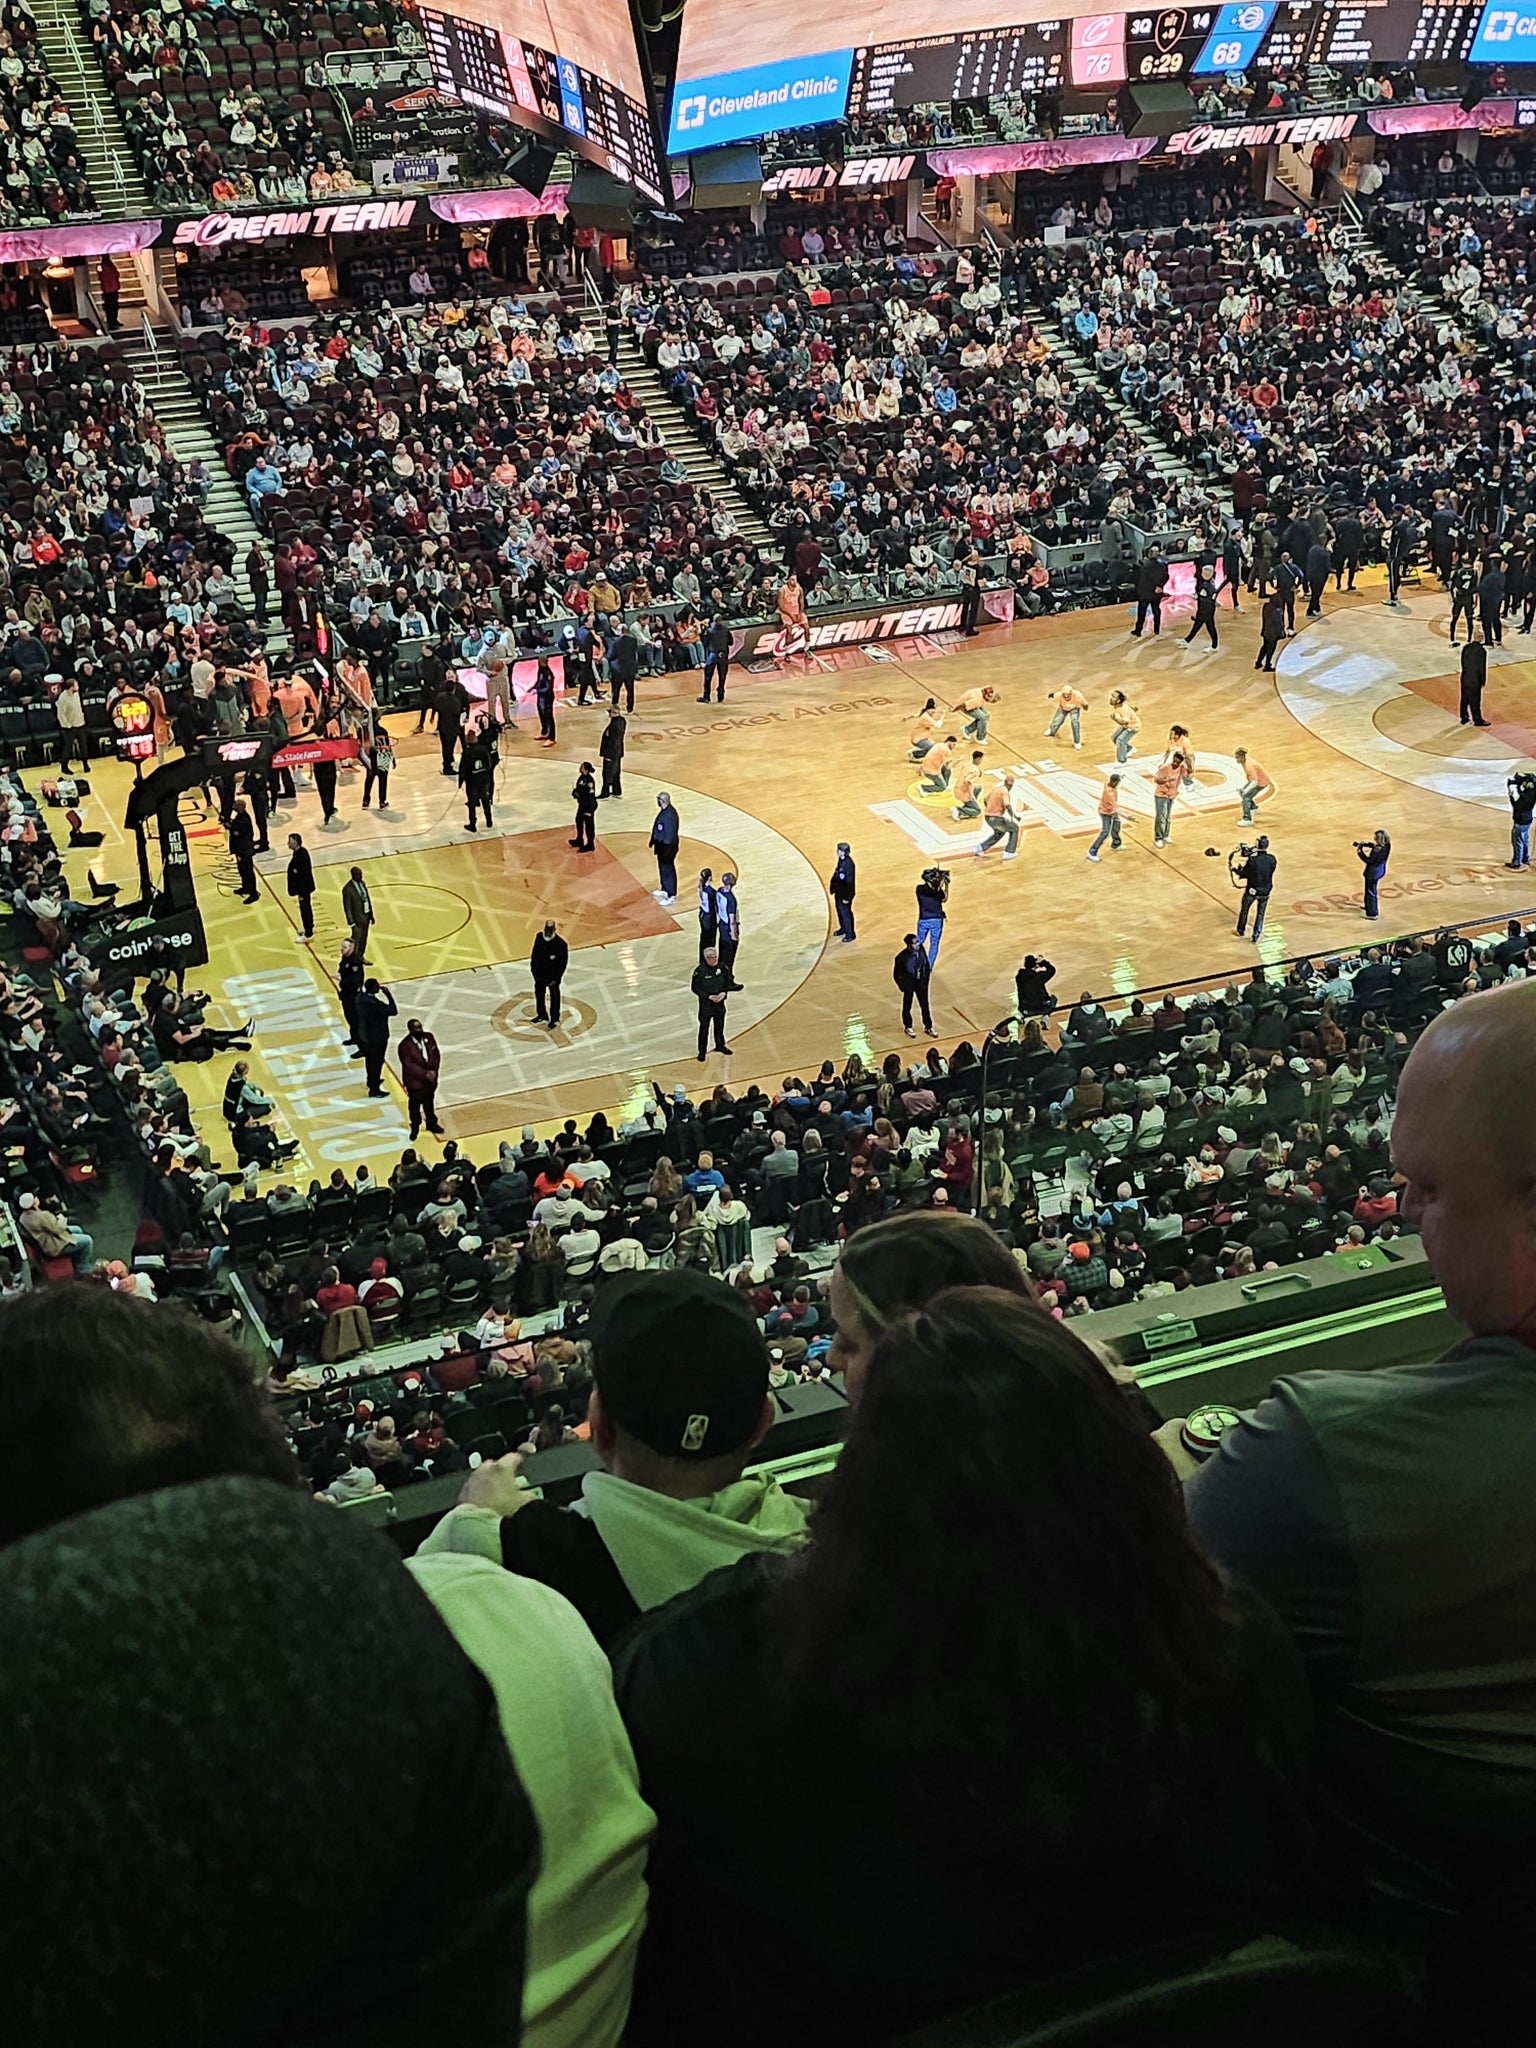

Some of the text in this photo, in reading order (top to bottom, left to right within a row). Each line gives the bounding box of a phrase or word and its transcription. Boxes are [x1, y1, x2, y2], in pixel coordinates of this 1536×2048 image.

[1131, 18, 1152, 35] 3Q
[1192, 13, 1210, 29] 14
[995, 28, 1010, 38] AST
[874, 35, 955, 55] CLEVELAND CAVALIERS
[1212, 42, 1242, 66] 68
[873, 53, 905, 67] MOBLEY
[1085, 53, 1112, 77] 76
[1140, 53, 1183, 75] 6:29
[871, 65, 901, 78] PORTER
[516, 79, 530, 105] 76
[708, 75, 839, 117] Cleveland Clinic
[1165, 115, 1358, 154] SCREAM TEAM
[404, 165, 428, 178] WTAM
[173, 201, 416, 246] SCREAM TEAM
[878, 603, 963, 639] TEAM
[126, 713, 145, 732] 14
[663, 695, 894, 740] Rocket Arena
[285, 750, 321, 761] State Farm
[984, 759, 1064, 781] THE
[866, 750, 1262, 856] LAND
